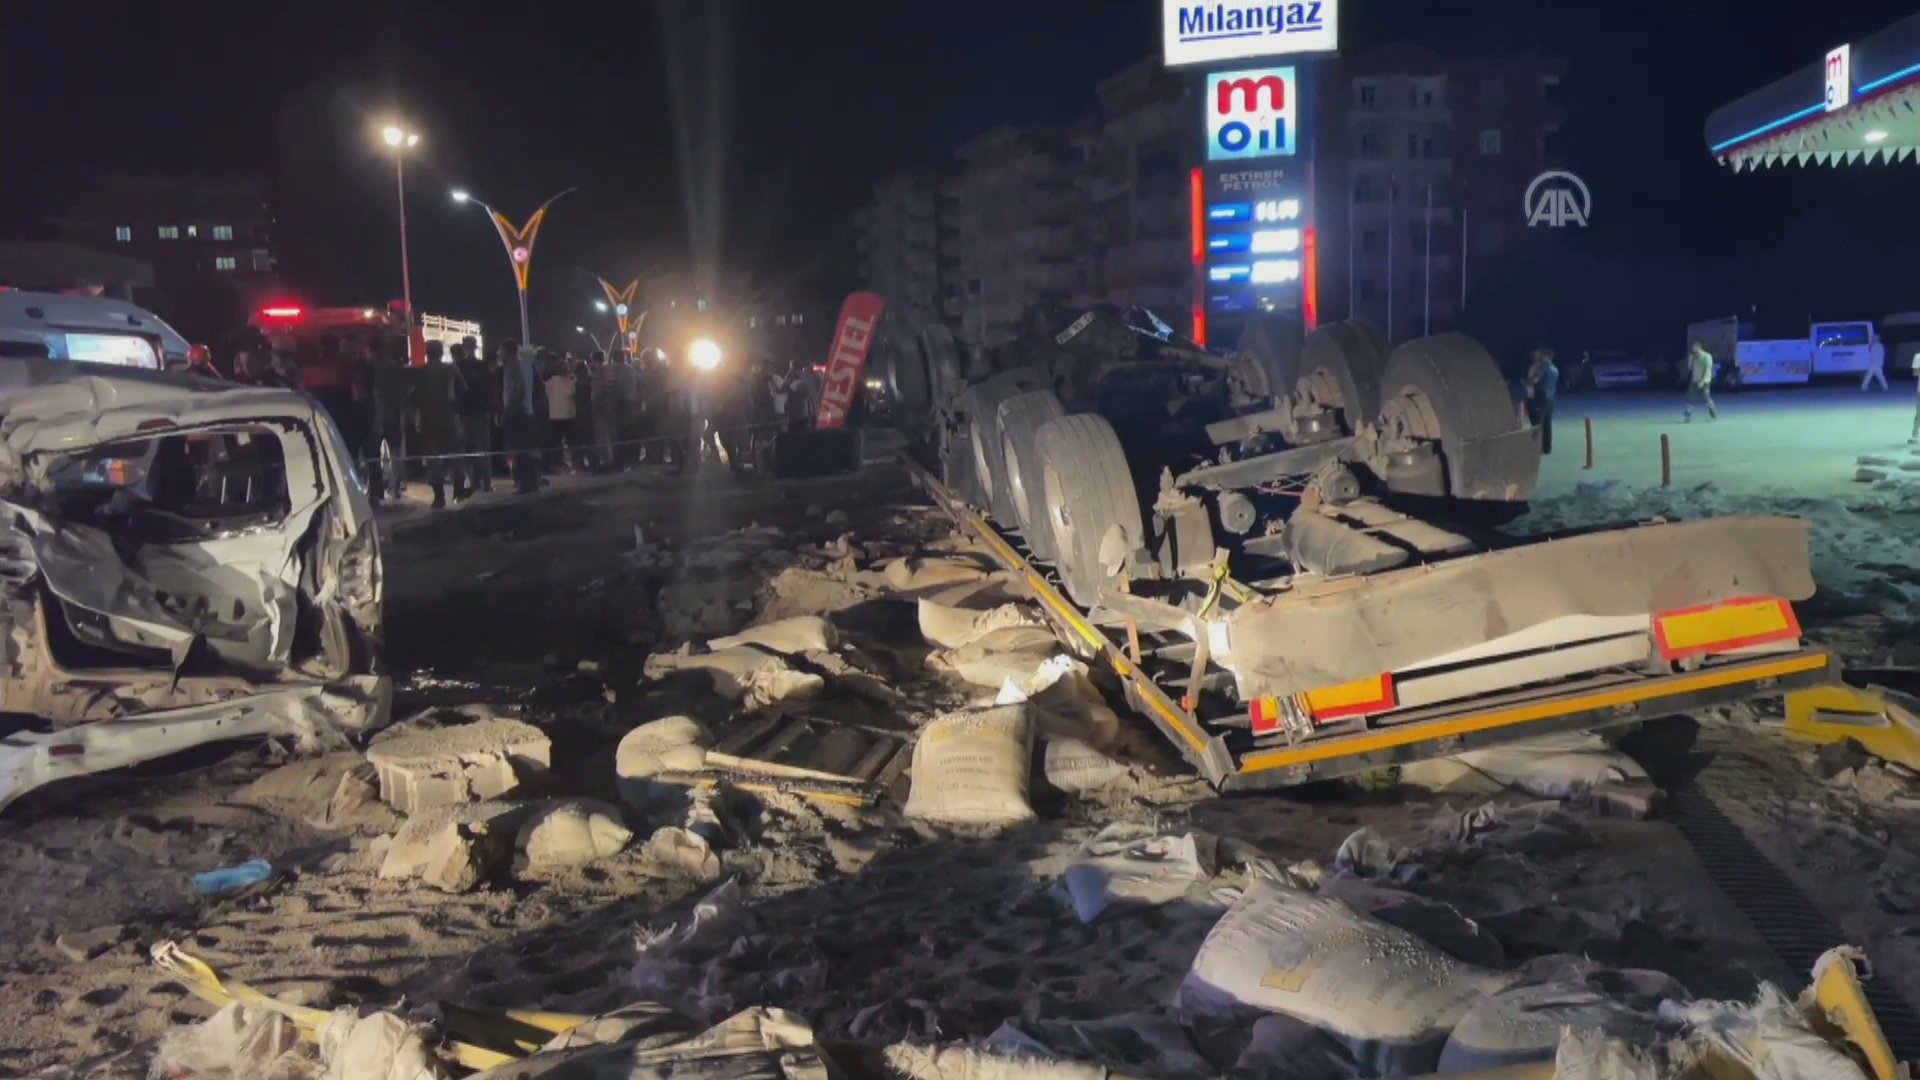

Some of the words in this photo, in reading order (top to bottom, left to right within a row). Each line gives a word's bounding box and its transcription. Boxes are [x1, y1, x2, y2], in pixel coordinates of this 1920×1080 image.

[1179, 1, 1322, 34] Milangaz
[1217, 75, 1285, 115] m
[1218, 117, 1286, 152] oil
[1223, 179, 1280, 192] PETROL
[816, 313, 875, 422] VESTEL
